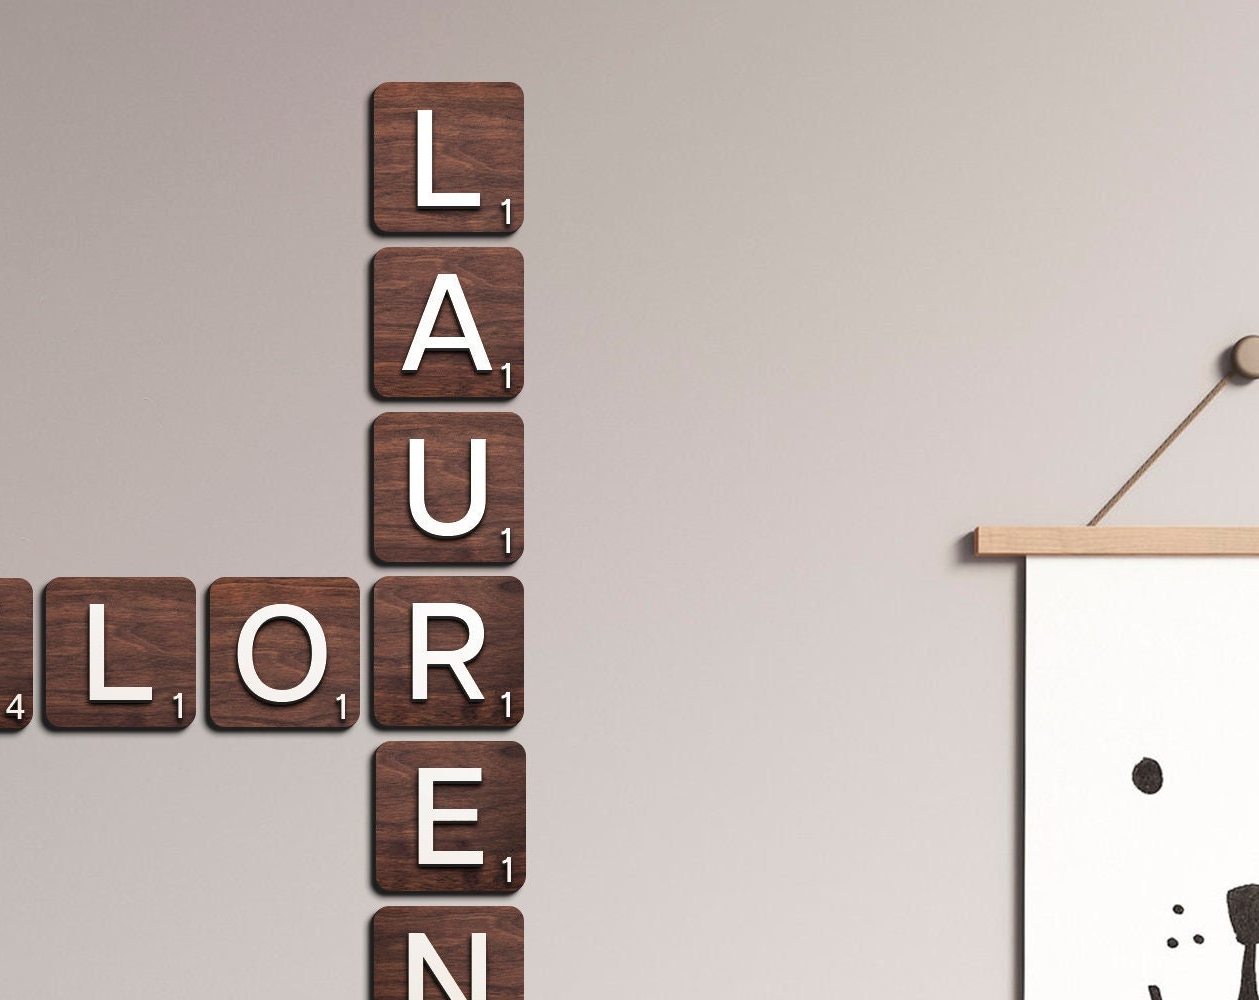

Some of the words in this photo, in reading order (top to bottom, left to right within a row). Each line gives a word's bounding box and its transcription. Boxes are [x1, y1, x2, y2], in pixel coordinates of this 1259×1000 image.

[499, 198, 511, 225] 1
[499, 362, 511, 389] 1
[499, 527, 511, 554] 1
[4, 693, 24, 720] 4
[172, 692, 183, 719] 1
[335, 693, 346, 720] 1
[500, 691, 511, 718] 1
[501, 856, 512, 883] 1
